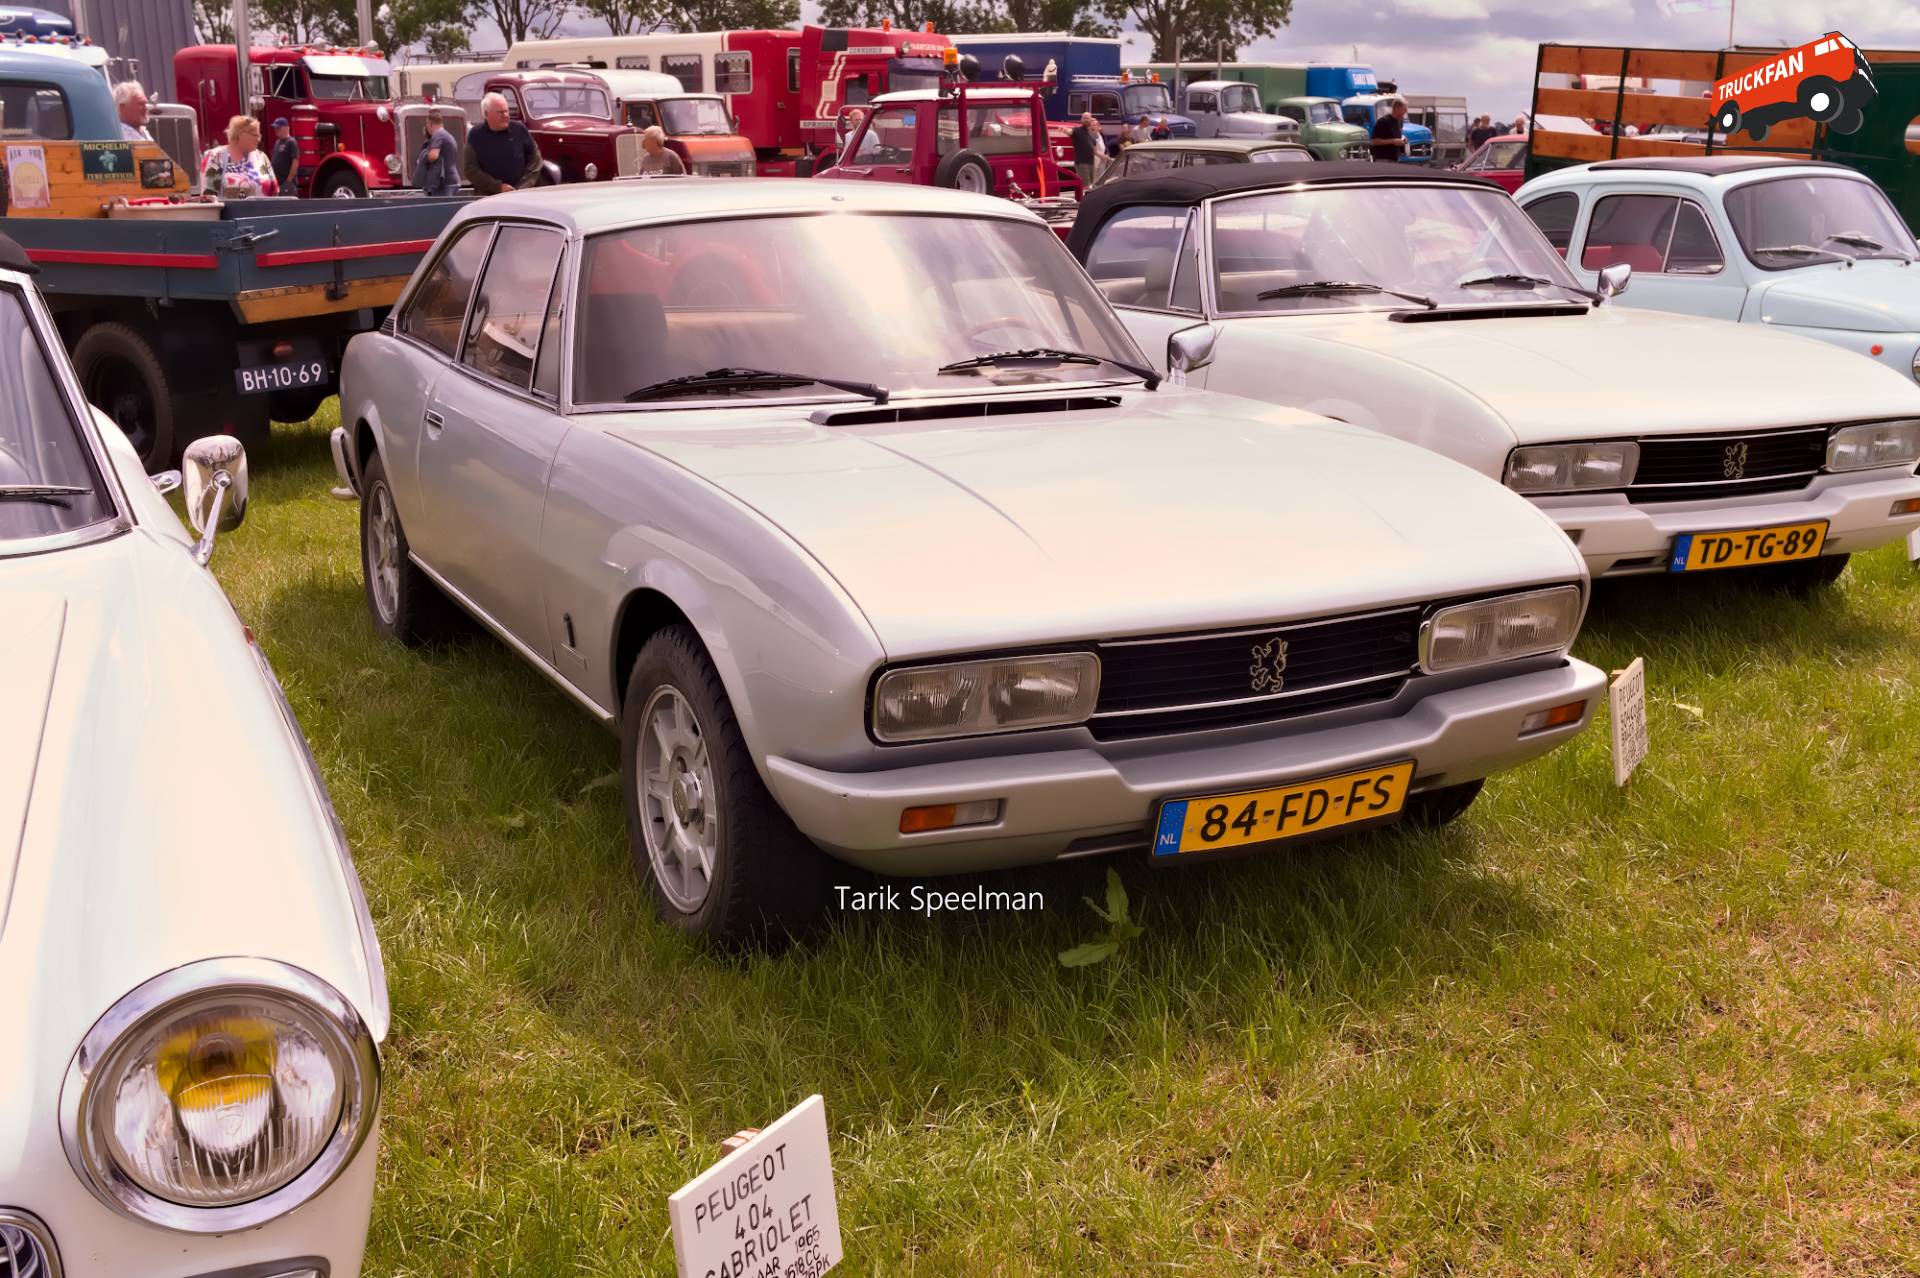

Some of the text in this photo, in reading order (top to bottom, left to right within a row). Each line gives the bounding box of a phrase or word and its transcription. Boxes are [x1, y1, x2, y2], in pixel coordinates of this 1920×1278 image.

[83, 143, 129, 151] MICHELIN
[1673, 529, 1817, 565] NL TD-TG-89
[1159, 774, 1394, 846] NL 84-FD-FS
[694, 1143, 786, 1234] PEUGEOT
[735, 1194, 773, 1240] 404
[795, 1224, 820, 1253] 1965
